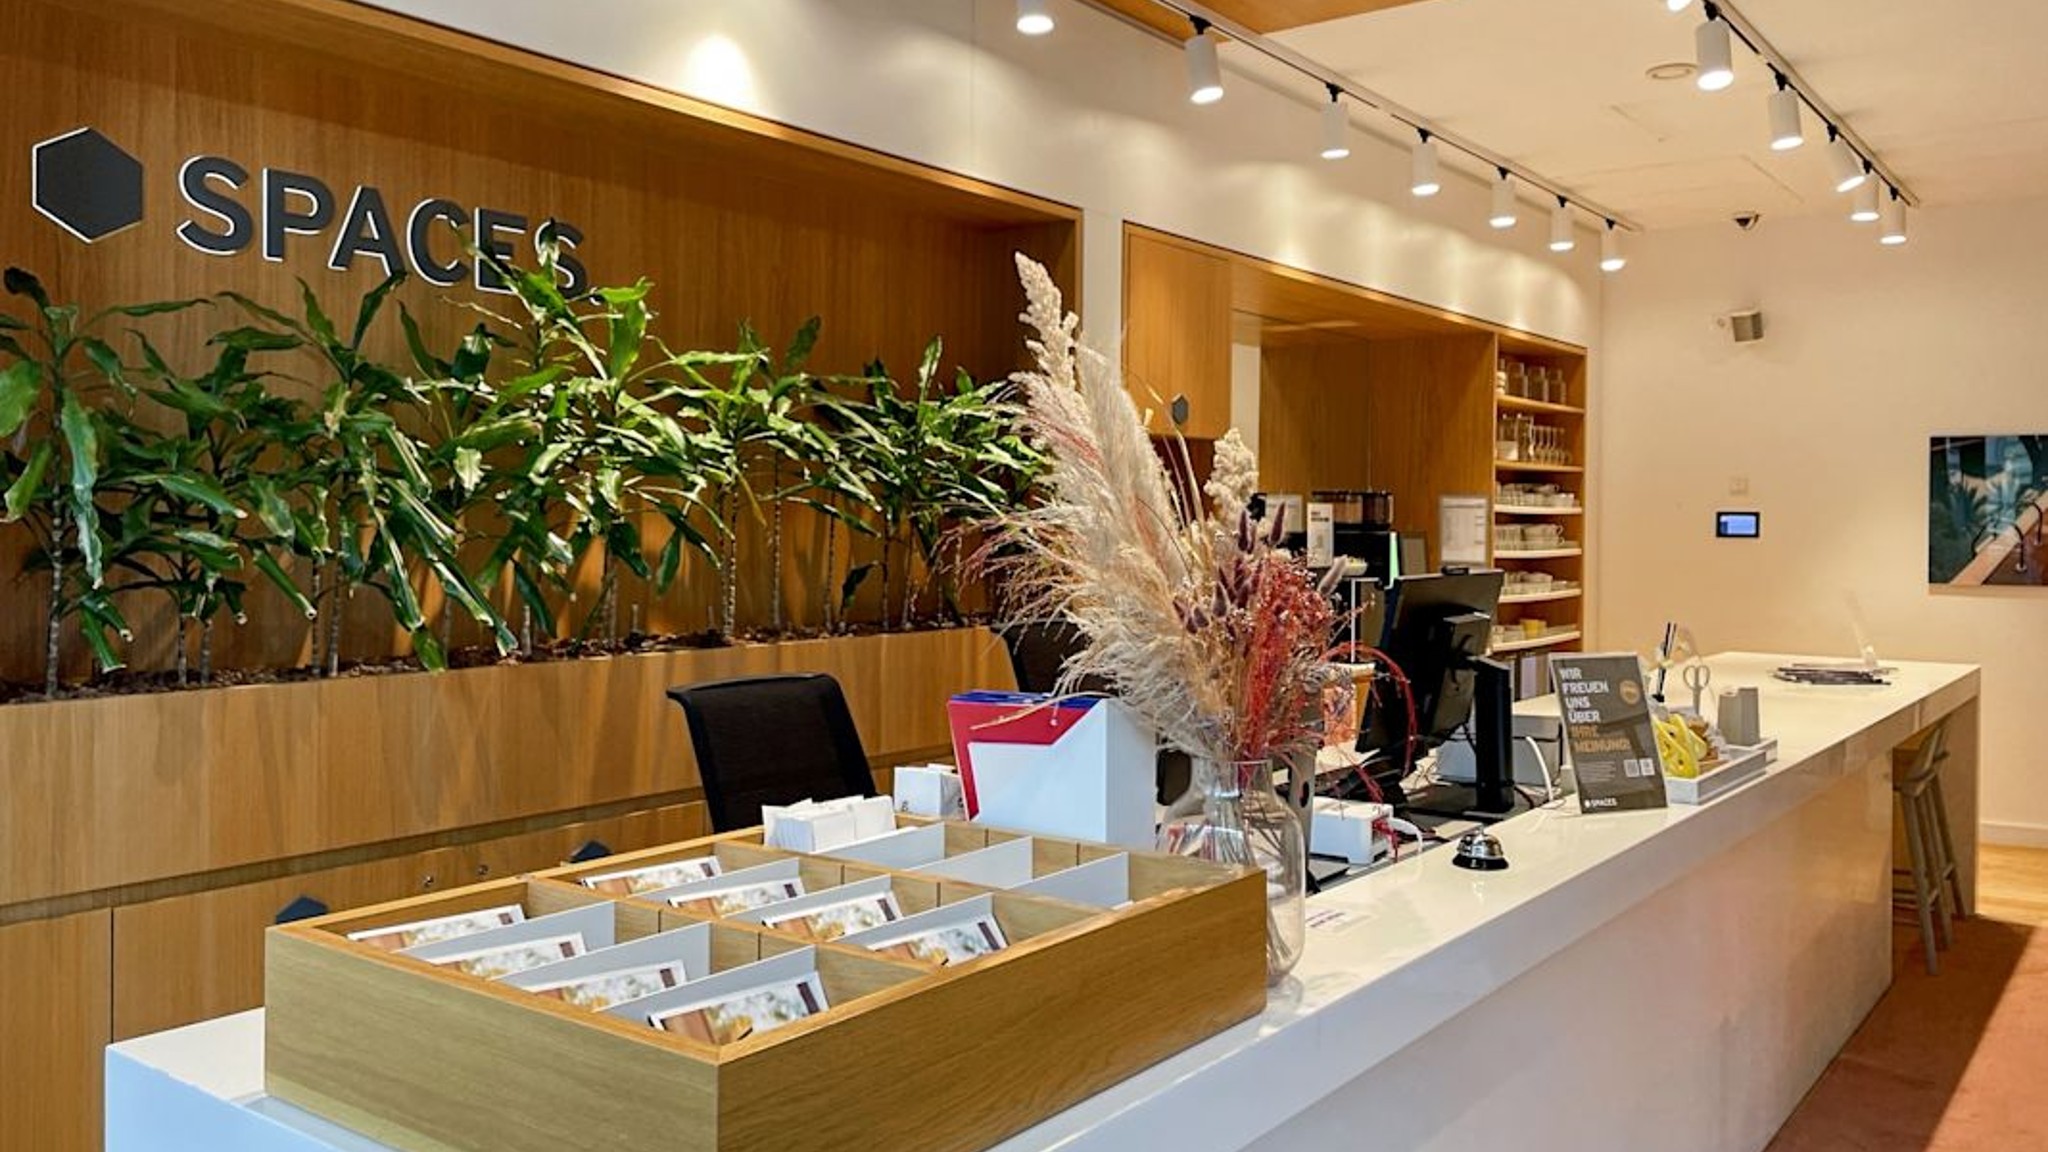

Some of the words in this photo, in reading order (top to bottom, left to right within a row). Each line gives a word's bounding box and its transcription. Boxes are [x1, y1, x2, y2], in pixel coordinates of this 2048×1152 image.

[1559, 667, 1582, 680] WIR
[1562, 681, 1609, 694] FREUEN
[1565, 696, 1591, 709] UNS
[1568, 710, 1600, 723] ÜBER
